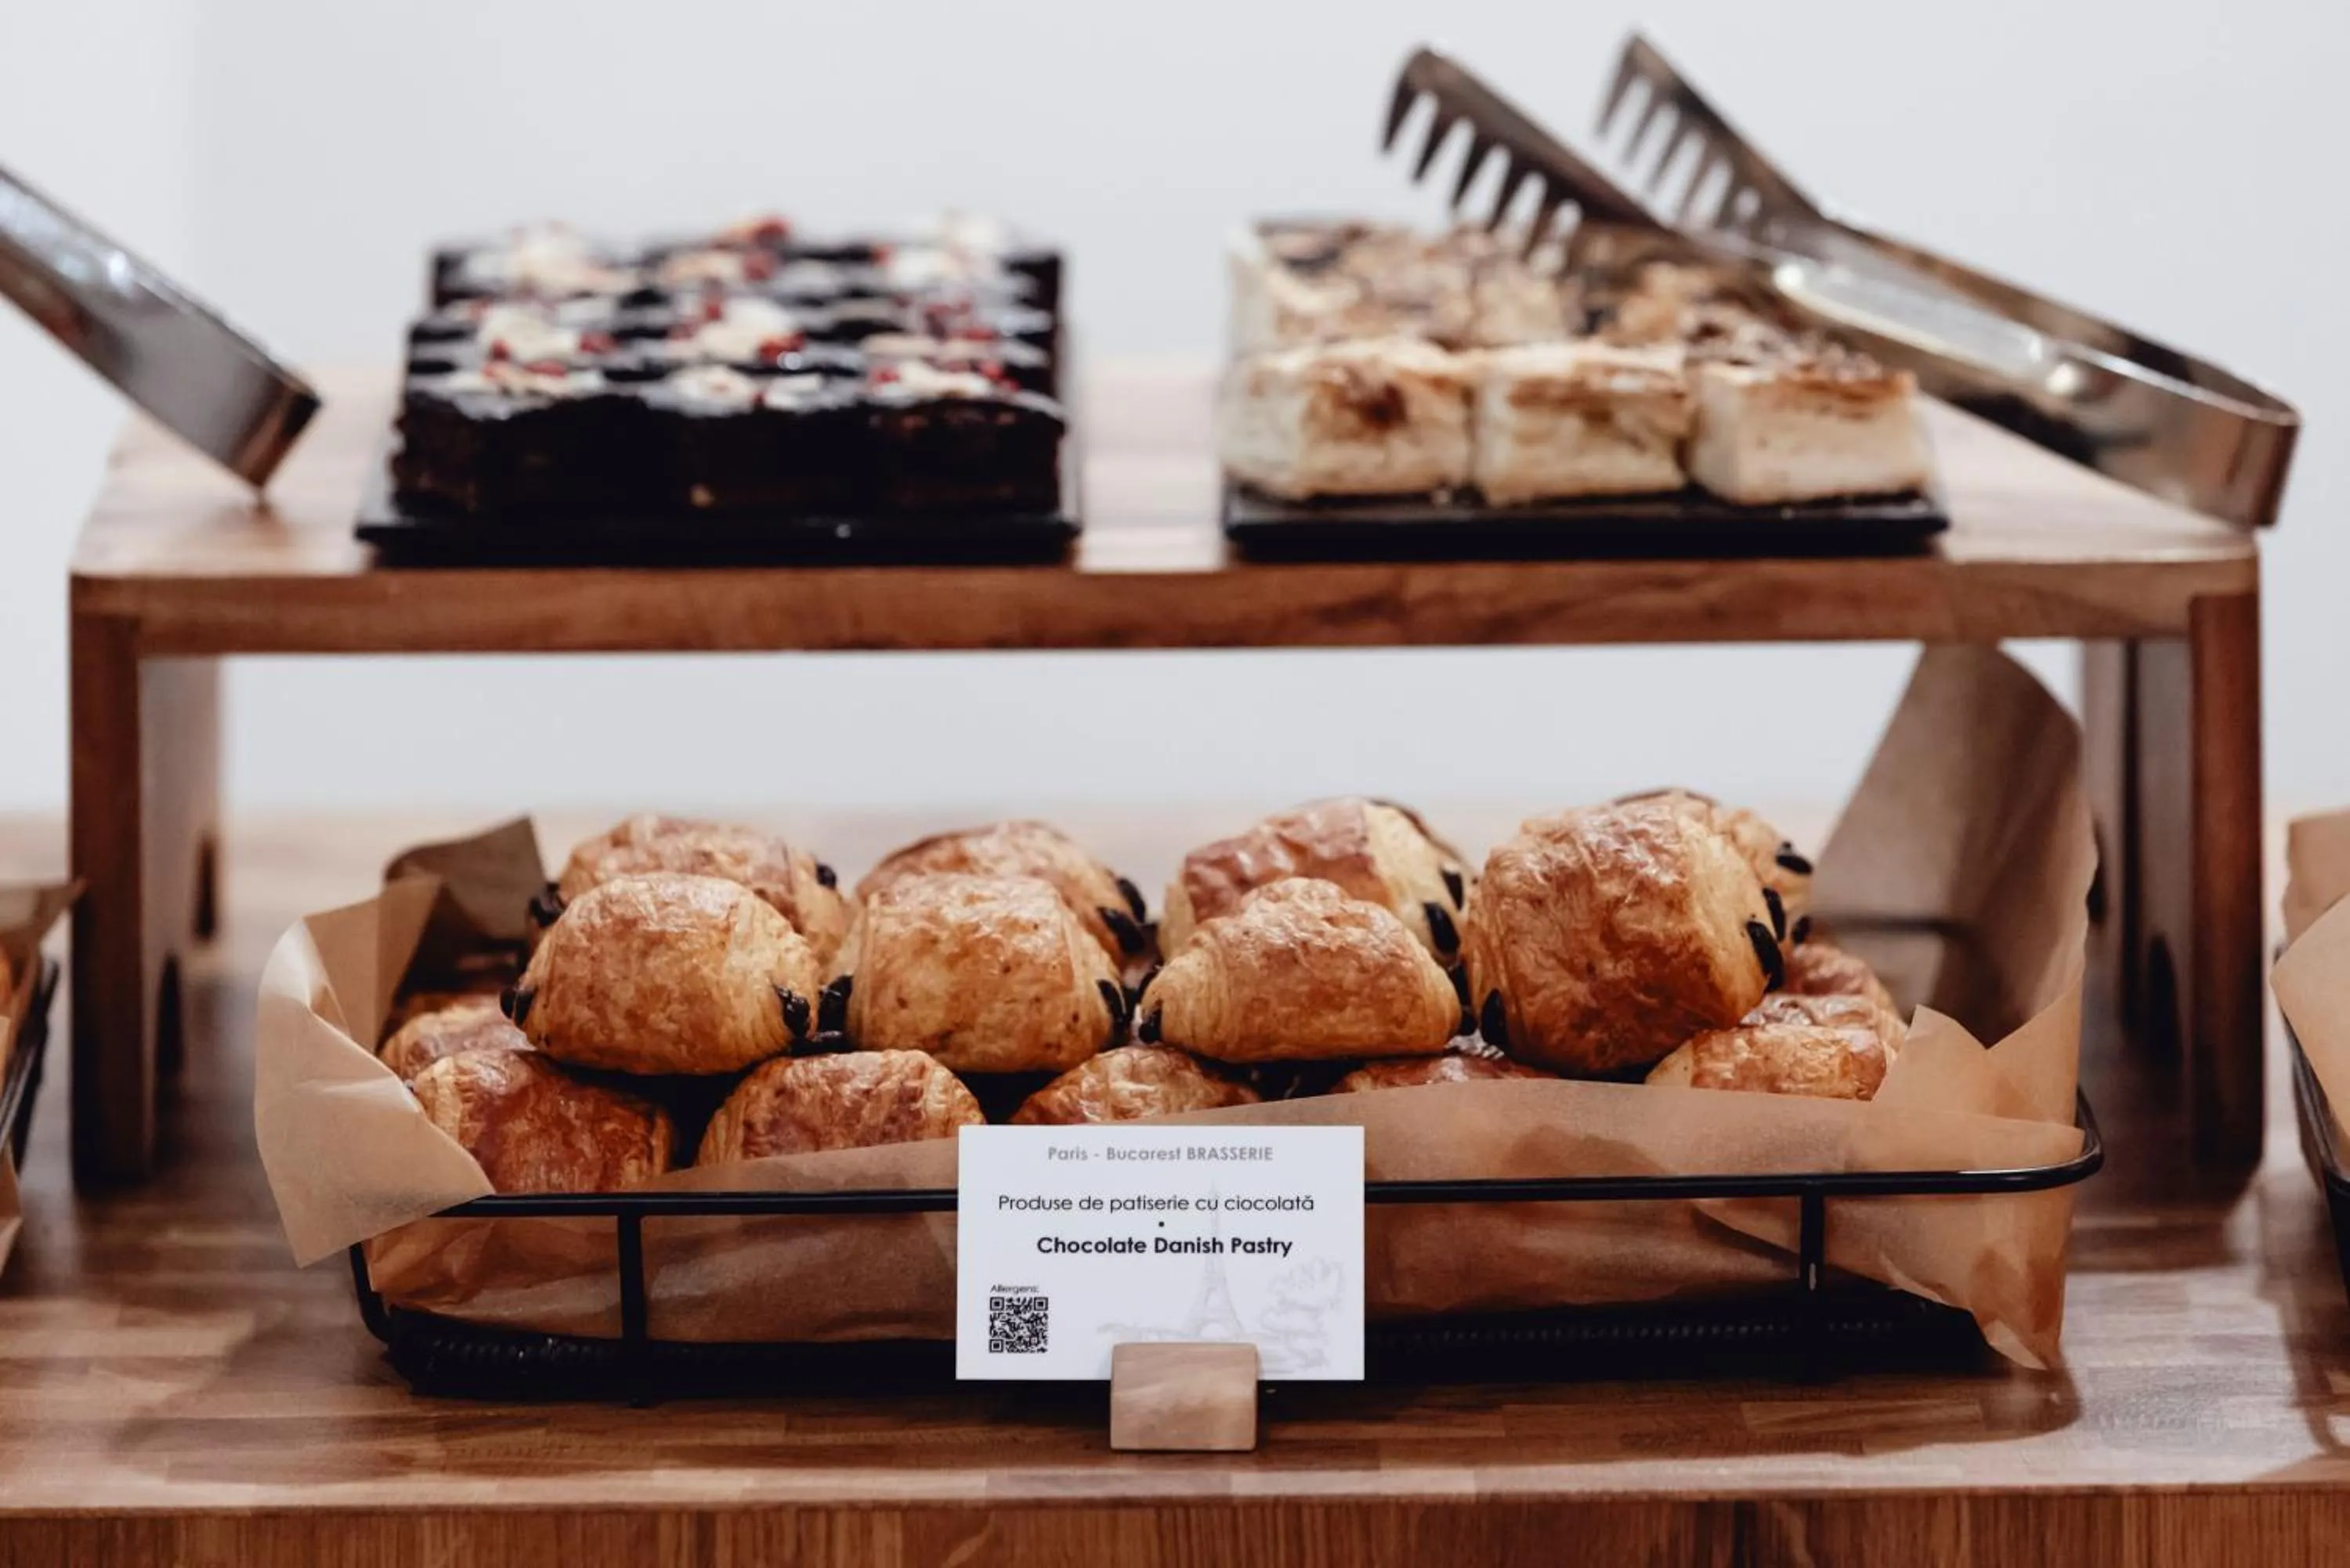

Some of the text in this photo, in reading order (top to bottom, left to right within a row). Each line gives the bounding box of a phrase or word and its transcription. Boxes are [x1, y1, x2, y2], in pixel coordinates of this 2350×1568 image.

[1048, 1147, 1088, 1161] Paris
[1106, 1147, 1181, 1161] Bucarest
[1187, 1147, 1274, 1161] BRASSERIE
[998, 1194, 1315, 1215] Produse de patiserie cu ciocolată
[1036, 1236, 1293, 1259] Chocolate Danish Pastry
